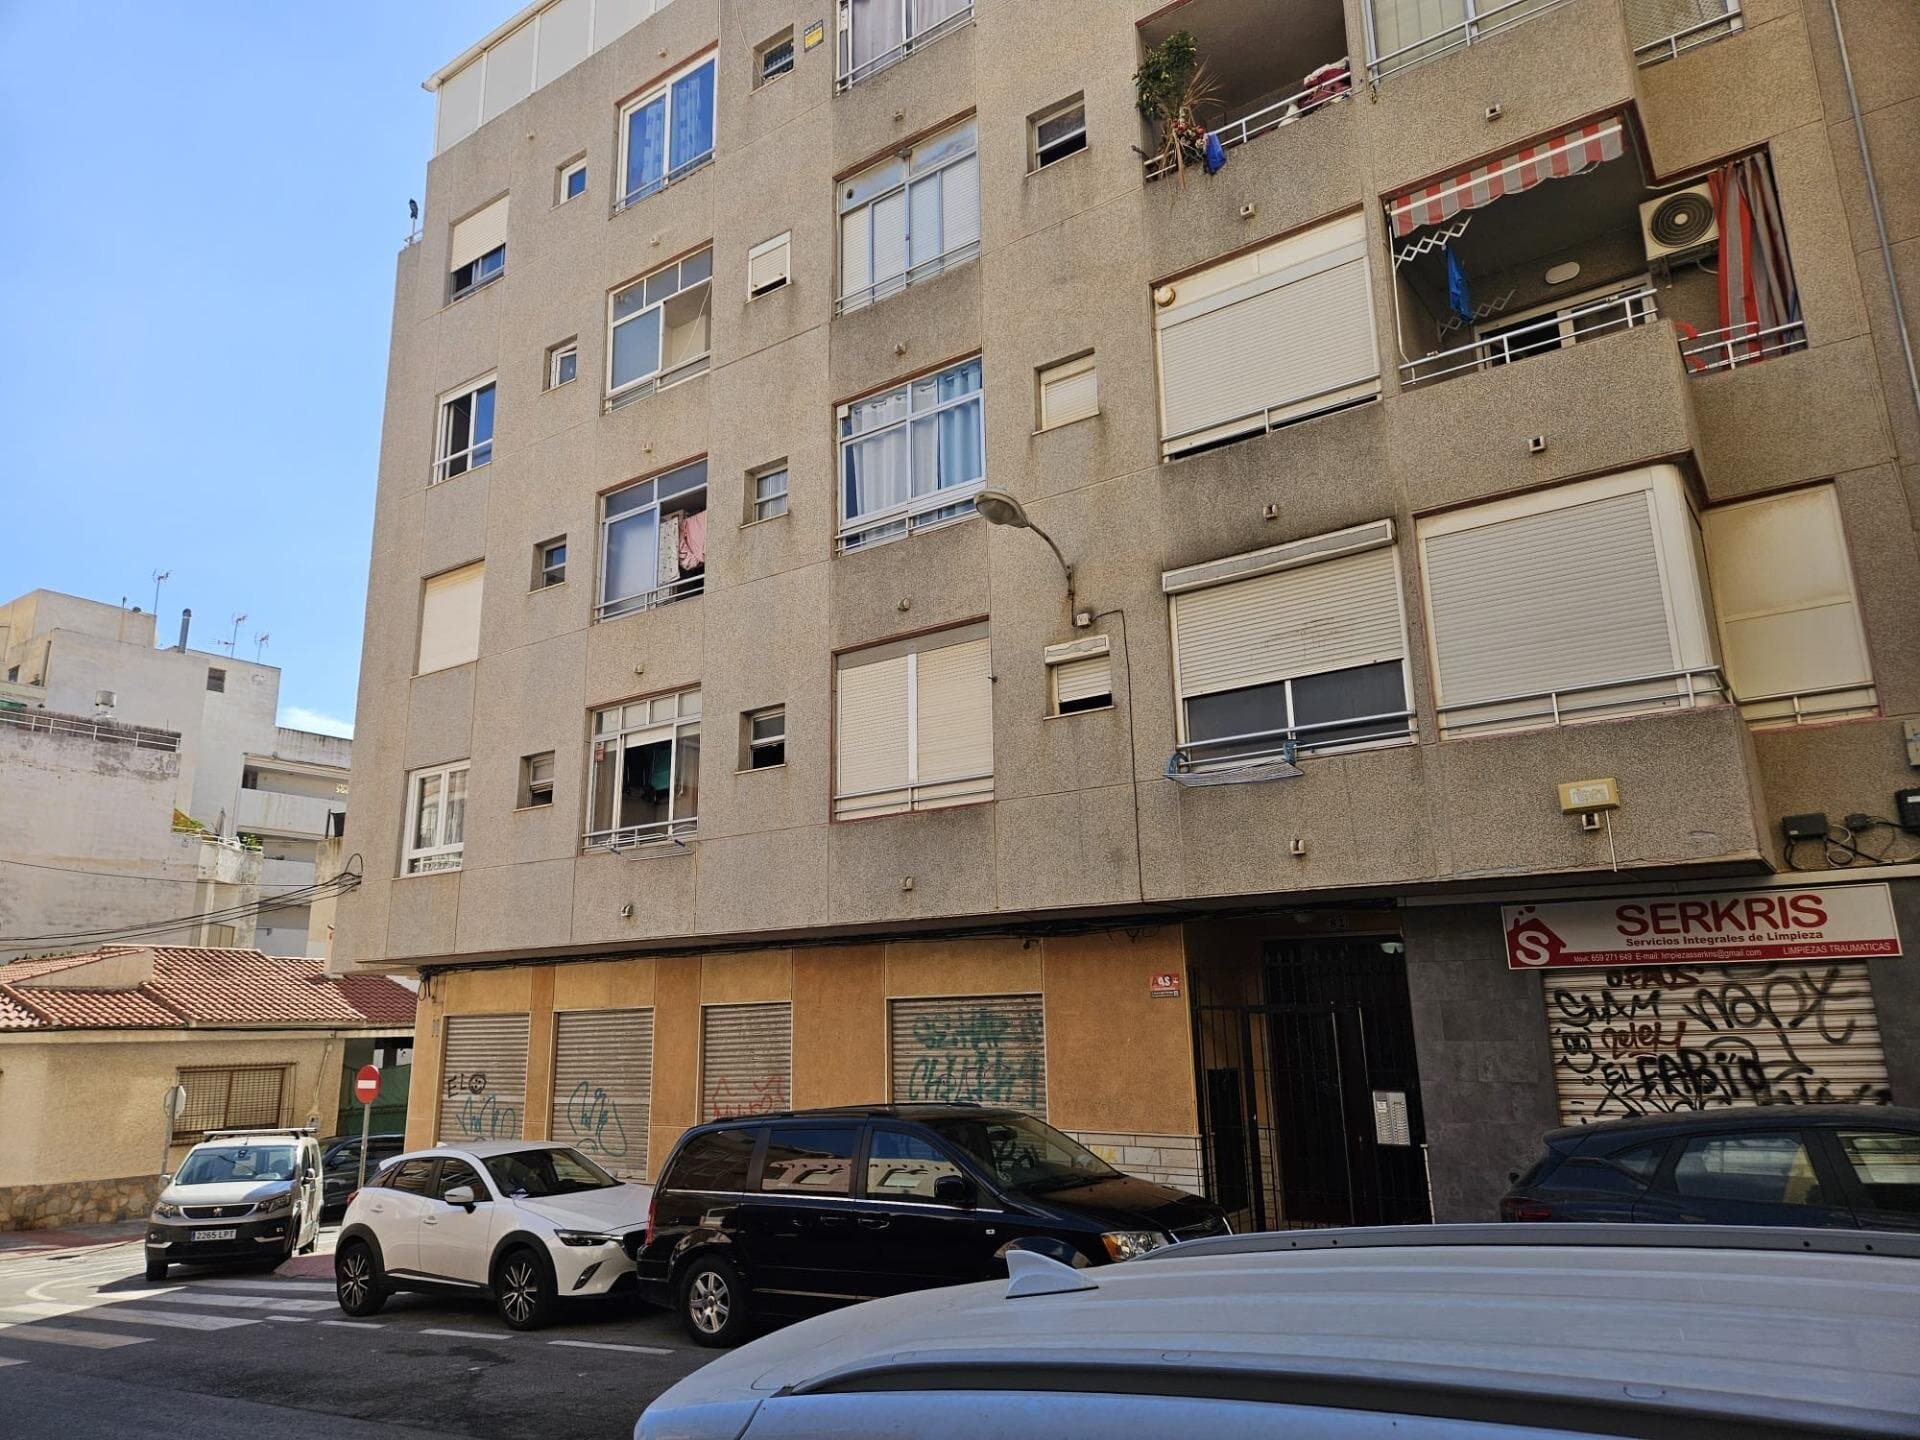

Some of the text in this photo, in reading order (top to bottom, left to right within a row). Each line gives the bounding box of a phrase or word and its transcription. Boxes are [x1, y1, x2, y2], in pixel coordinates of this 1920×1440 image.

[1615, 894, 1828, 936] SERKRIS
[1516, 930, 1549, 966] S
[1626, 930, 1824, 947] Servicios Integrales de Limpieza
[1783, 942, 1892, 955] LIMPIEZAS TRAUMATICAS
